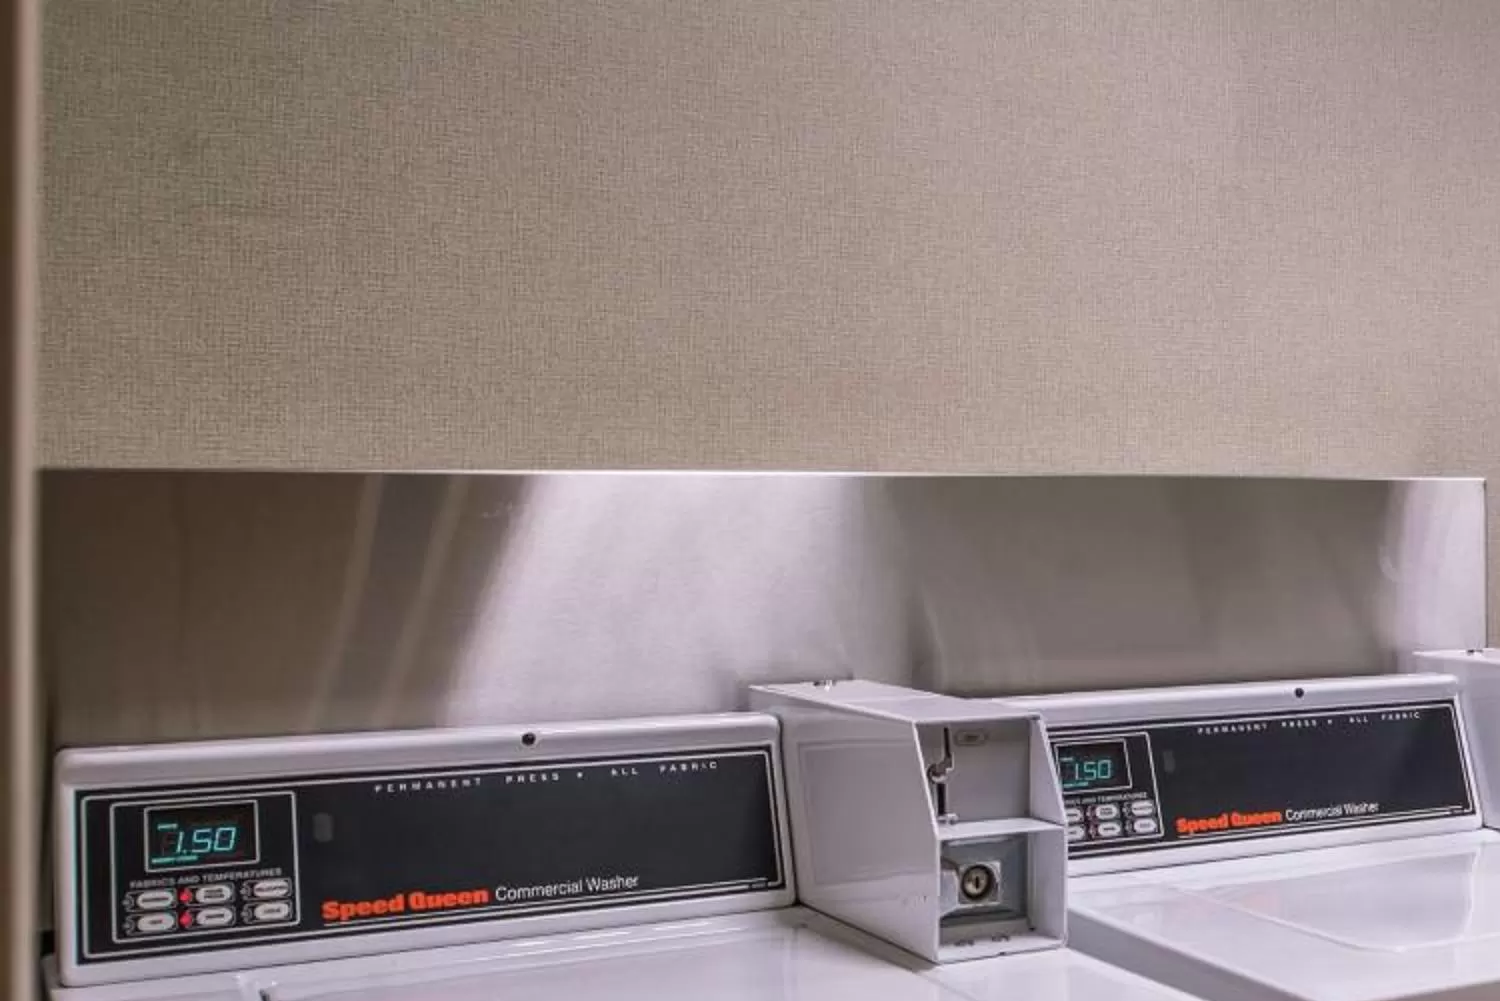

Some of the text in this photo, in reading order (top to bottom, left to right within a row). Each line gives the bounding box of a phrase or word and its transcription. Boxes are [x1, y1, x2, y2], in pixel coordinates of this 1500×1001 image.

[374, 760, 718, 794] PERMANENT PRESS ALL FABRIC
[1175, 801, 1380, 834] Speed Queen Commercial Washer
[321, 874, 639, 920] Speed Queen Commercial Washer
